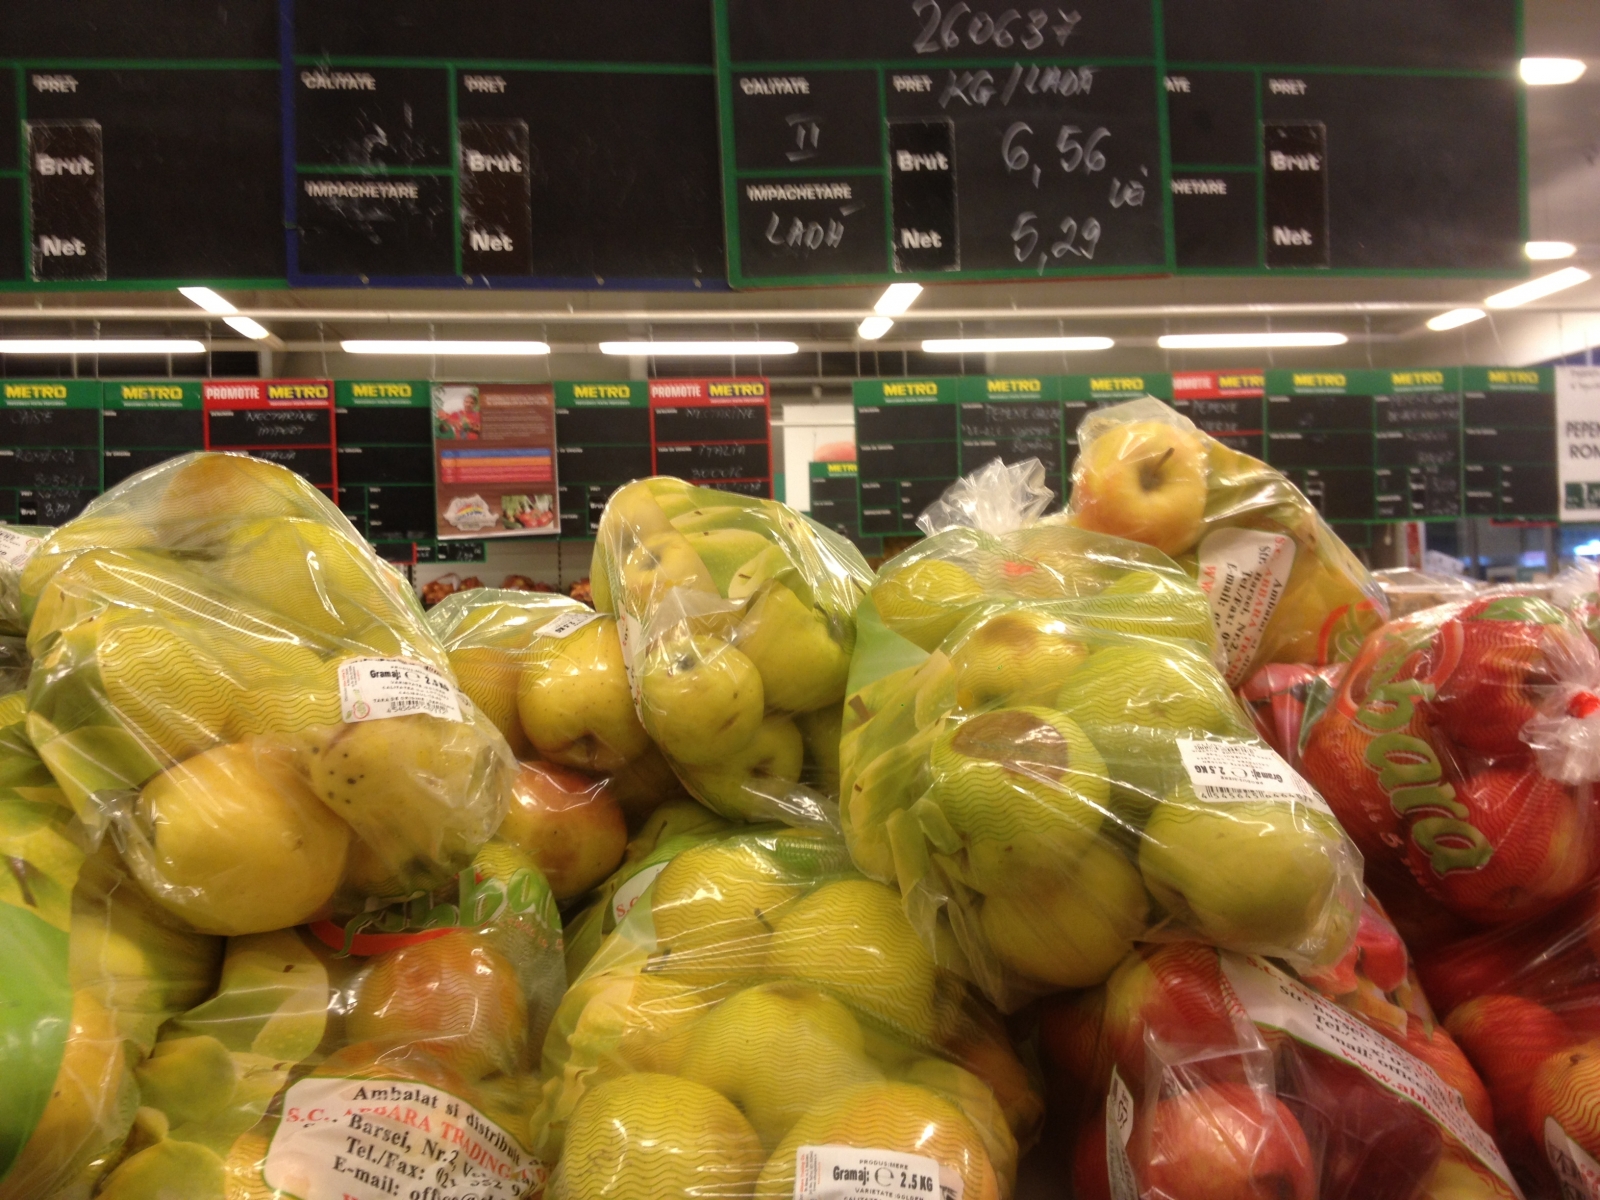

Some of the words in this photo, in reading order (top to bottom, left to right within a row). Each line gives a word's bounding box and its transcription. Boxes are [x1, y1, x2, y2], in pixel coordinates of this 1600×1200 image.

[33, 75, 79, 93] PRET
[301, 71, 377, 91] CALITATE
[464, 75, 507, 94] PRET
[740, 77, 811, 95] CALITATE
[893, 75, 933, 93] PRET
[37, 153, 95, 176] Brut
[468, 149, 523, 173] Brut
[897, 150, 949, 172] Brut
[1270, 151, 1323, 172] Brut
[304, 181, 419, 199] IMPACHETARE
[746, 183, 852, 201] IMPACHETARE
[471, 229, 514, 252] Net
[902, 228, 943, 249] Net
[1272, 226, 1312, 246] Net
[40, 235, 86, 257] Net
[987, 379, 1041, 393] METRO
[1090, 377, 1144, 392] METRO
[1293, 373, 1347, 387] METRO
[1392, 371, 1443, 385] METRO
[1487, 371, 1538, 385] METRO
[4, 384, 67, 399] METRO
[121, 386, 183, 401] METRO
[204, 386, 260, 400] PROMOTIE
[267, 385, 328, 398] METRO
[352, 383, 413, 398] METRO
[573, 384, 630, 399] METRO
[651, 384, 701, 398] PROMOTIE
[708, 382, 764, 397] METRO
[882, 381, 938, 397] METRO
[370, 669, 401, 680] Gramaj:
[1251, 769, 1283, 783] Gramaj:
[347, 1114, 411, 1153] Barsei,
[353, 1086, 439, 1109] Ambalat
[445, 1102, 459, 1118] si
[466, 1112, 523, 1167] distribuit
[286, 1107, 331, 1123] S.C.
[441, 1121, 511, 1181] TRADING
[347, 1136, 426, 1181] Tel./Fax:
[333, 1156, 400, 1197] E-mail:
[833, 1165, 870, 1186] Gramaj:
[920, 1173, 933, 1192] KG
[855, 1187, 893, 1198] VARIETATE
